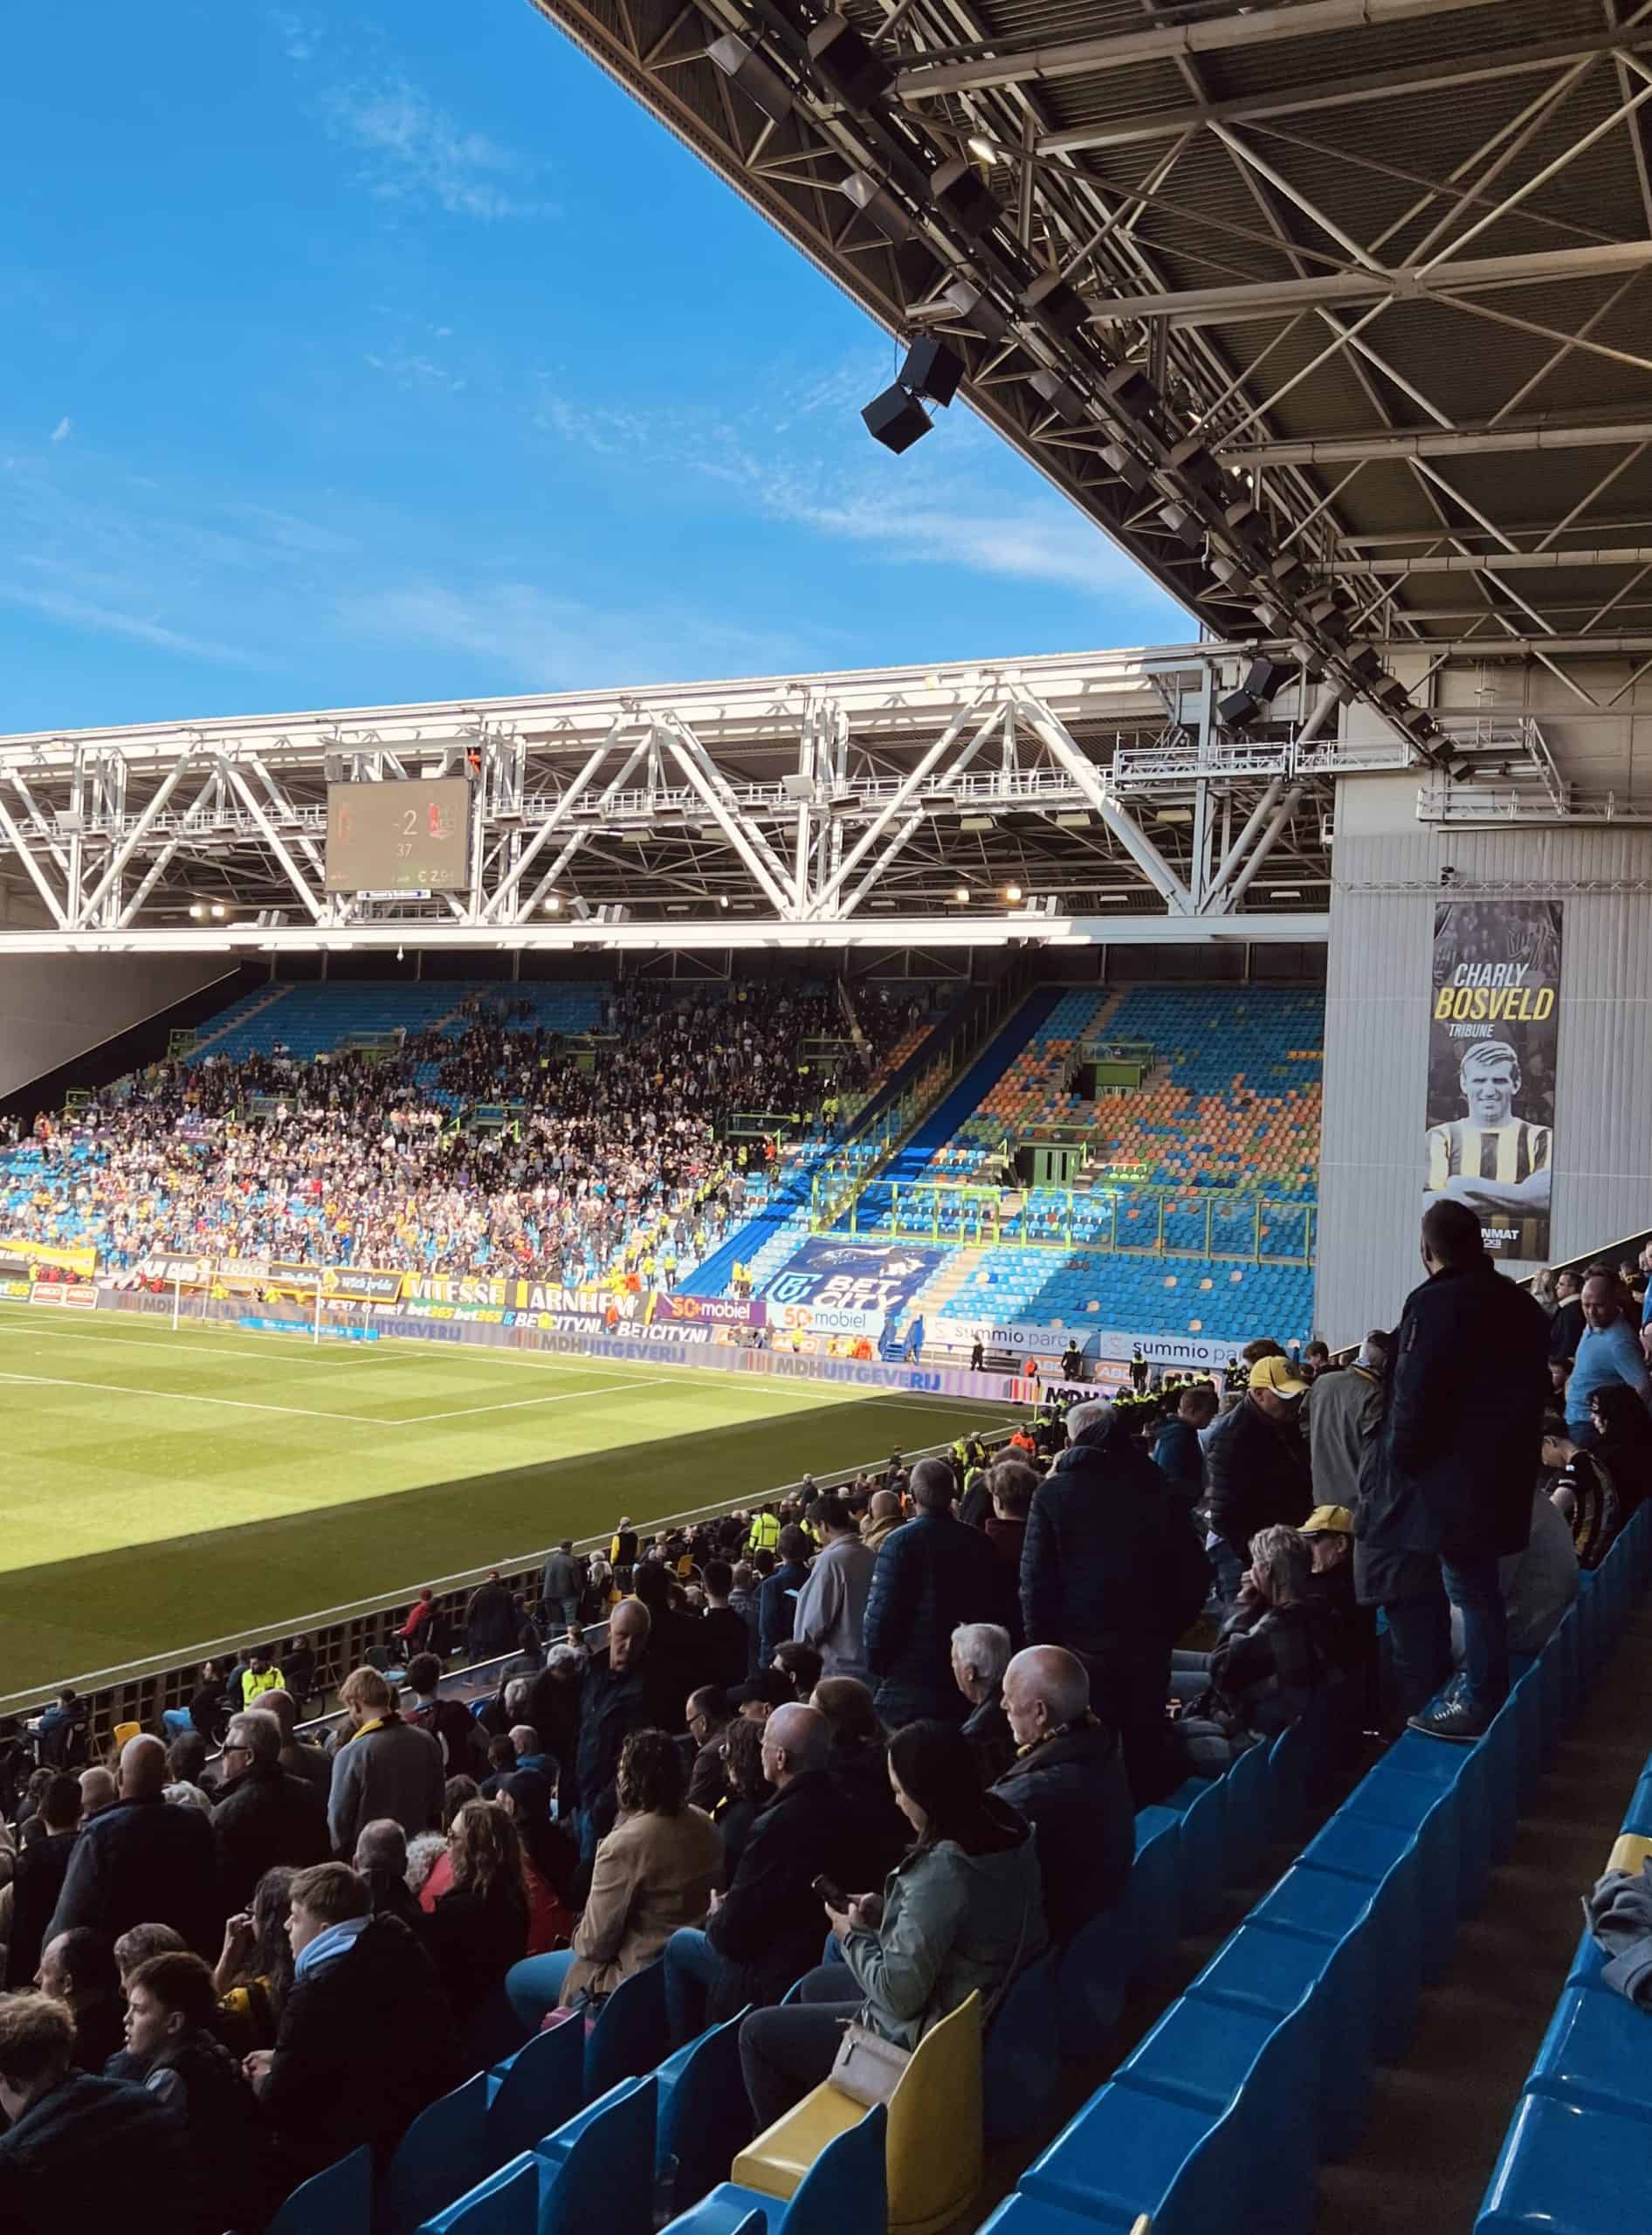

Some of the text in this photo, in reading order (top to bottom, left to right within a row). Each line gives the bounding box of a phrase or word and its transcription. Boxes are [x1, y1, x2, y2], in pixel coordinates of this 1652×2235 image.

[403, 809, 418, 836] 2
[1454, 963, 1529, 987] CHARLY
[1435, 987, 1554, 1020] BOSVELD
[1449, 1023, 1495, 1037] TRIBUNE
[1481, 1228, 1519, 1240] NMAT
[410, 1278, 506, 1304] VITESSE
[824, 1275, 902, 1294] BET
[406, 1303, 454, 1319] bet365
[530, 1287, 636, 1318] ARNHEM
[813, 1291, 904, 1313] CITY
[454, 1307, 503, 1324] bet365
[954, 1326, 1024, 1344] summio
[540, 1332, 685, 1364] MDHUITGEVERIJ
[1133, 1341, 1209, 1359] summio
[775, 1357, 941, 1392] MDHUITGEVERIJ
